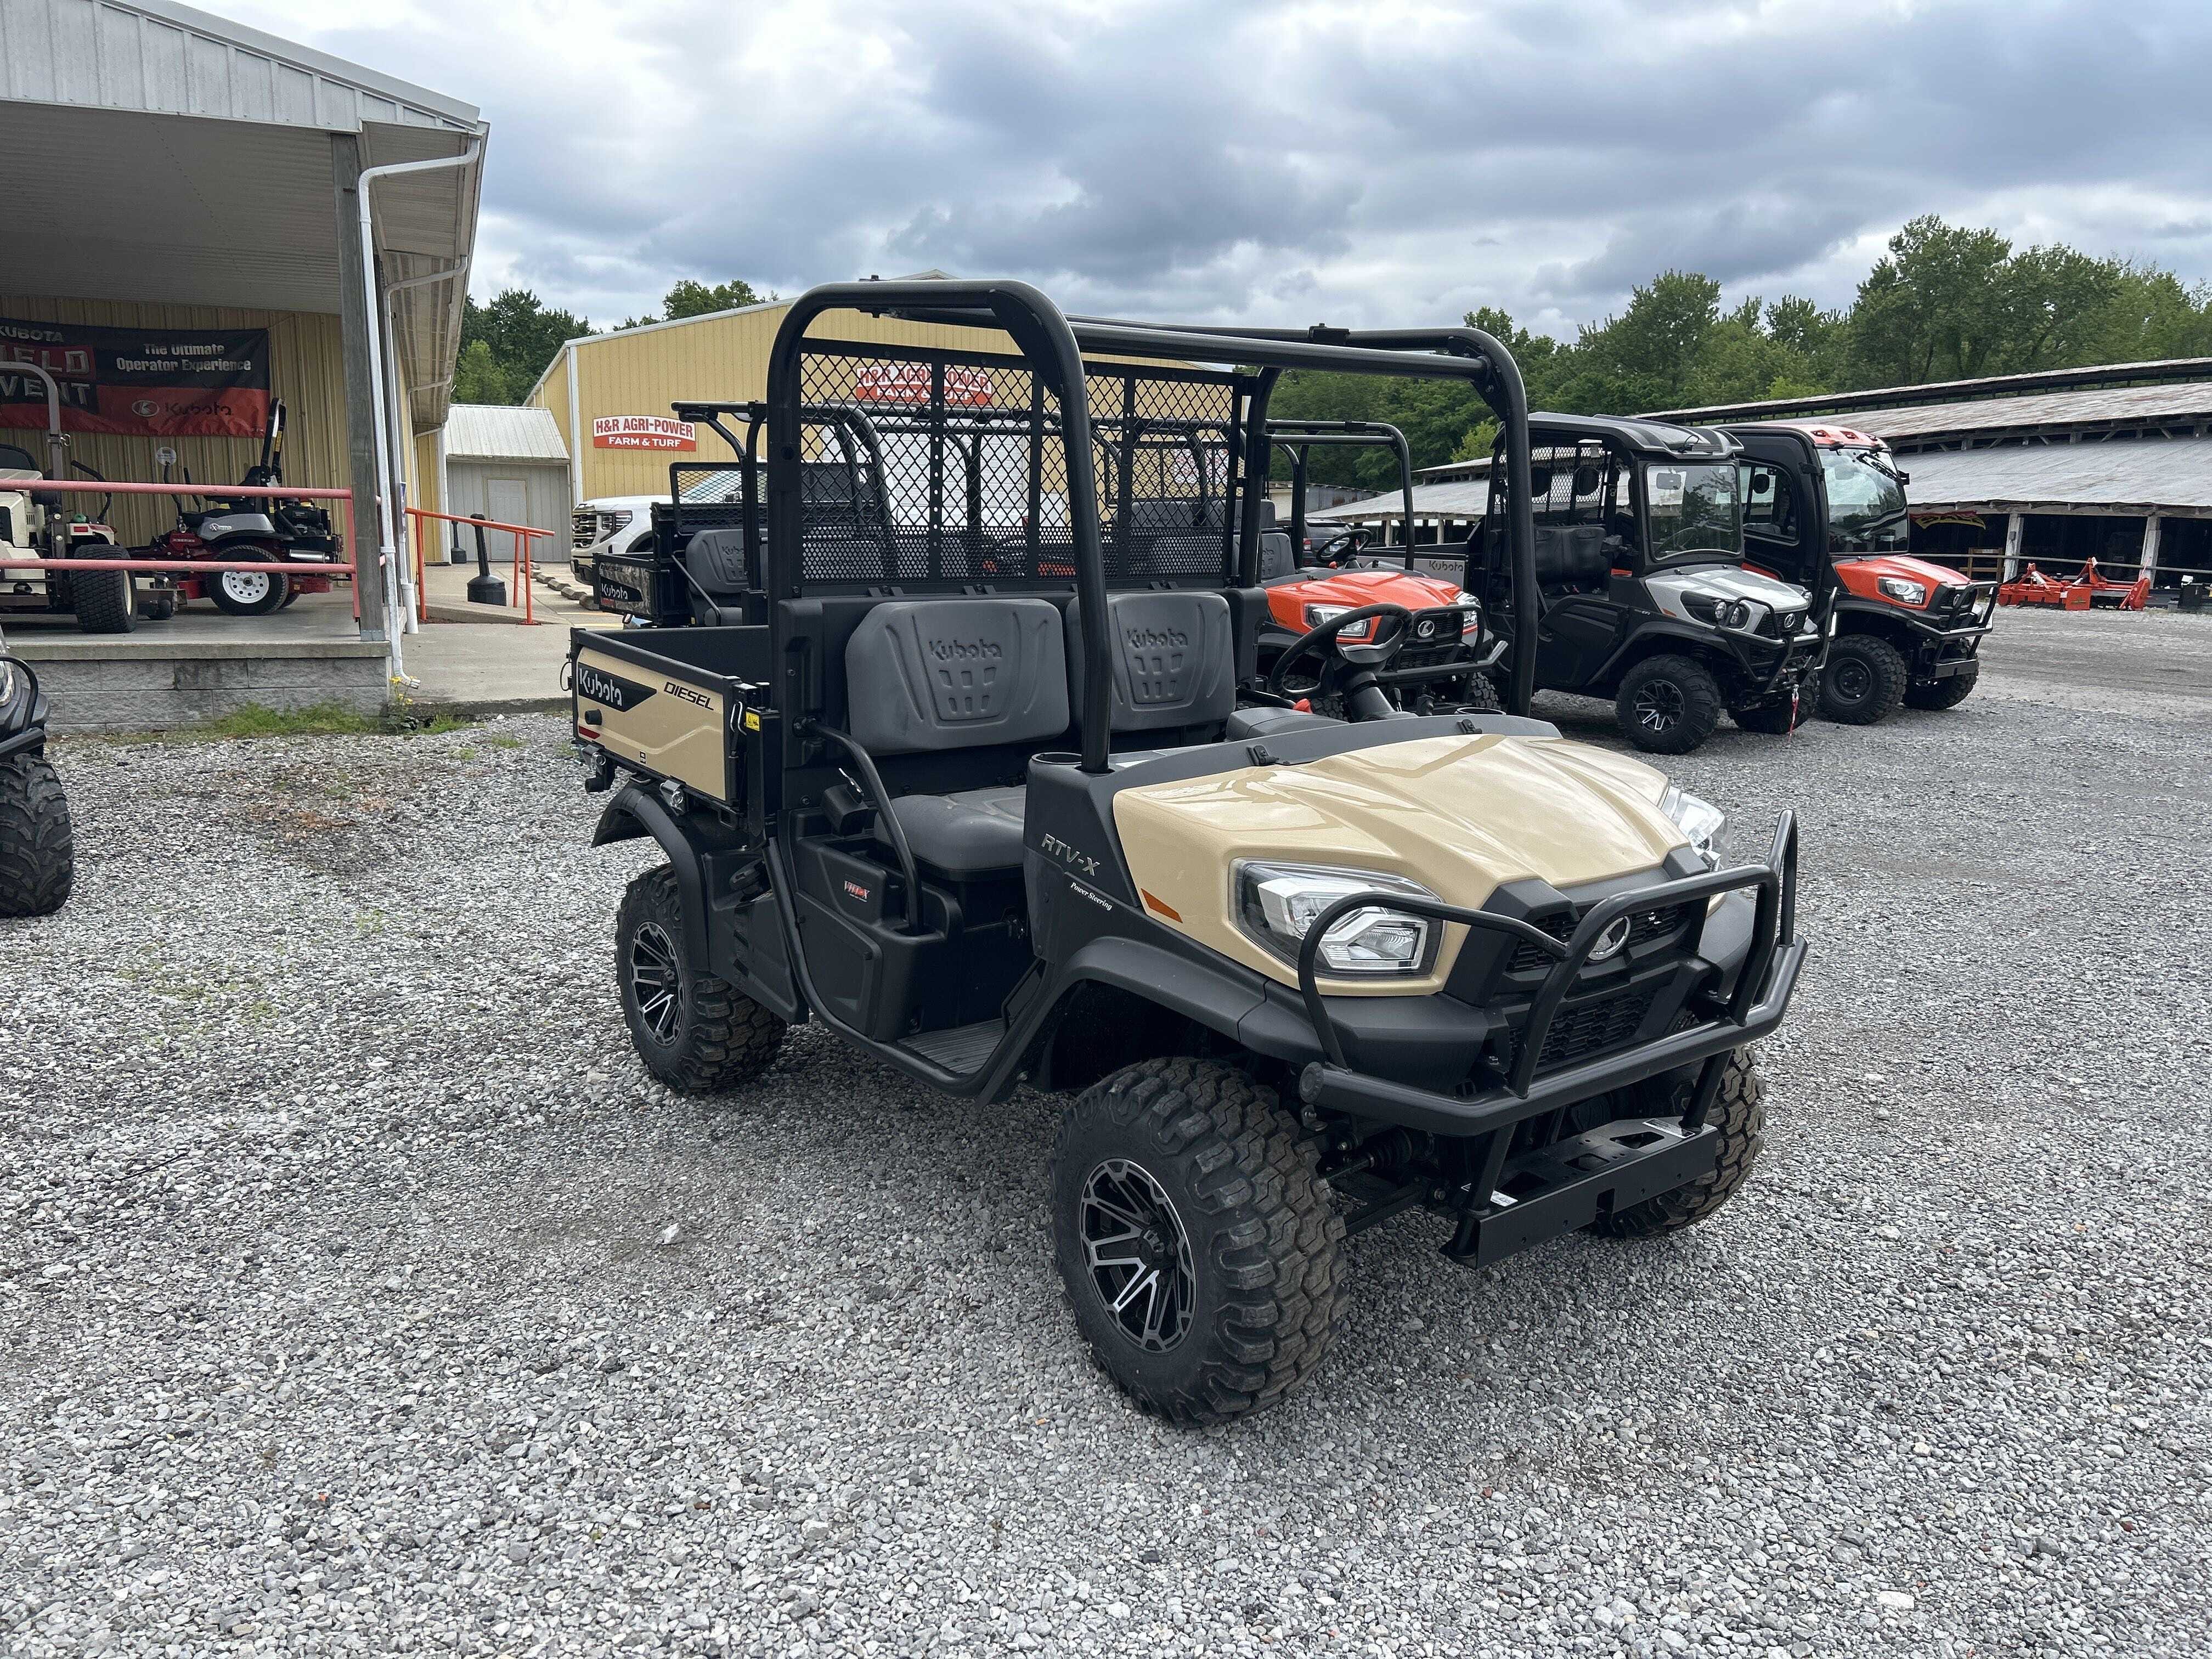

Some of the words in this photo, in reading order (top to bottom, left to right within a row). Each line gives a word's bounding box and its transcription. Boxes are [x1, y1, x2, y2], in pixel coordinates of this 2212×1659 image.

[143, 343, 167, 355] The
[171, 343, 224, 356] Ultimate
[116, 358, 178, 372] Operator
[182, 359, 251, 372] Experience
[860, 368, 891, 383] H&R
[877, 387, 917, 398] FARM
[921, 388, 931, 398] &
[944, 390, 974, 400] URF
[166, 401, 232, 416] Kubota
[596, 419, 619, 433] H&R
[623, 418, 693, 438] AGRI-POWER
[608, 437, 640, 445] FARM
[652, 438, 681, 447] TURF
[1429, 561, 1463, 571] Kubota
[601, 583, 628, 600] Kubota
[1126, 628, 1188, 648] Kubota
[929, 639, 1002, 660] Kubota
[579, 668, 622, 707] Kubota
[663, 681, 714, 710] DIESEL
[1042, 833, 1101, 876] RTV-X
[1070, 882, 1089, 896] Power
[1087, 892, 1113, 911] Steering
